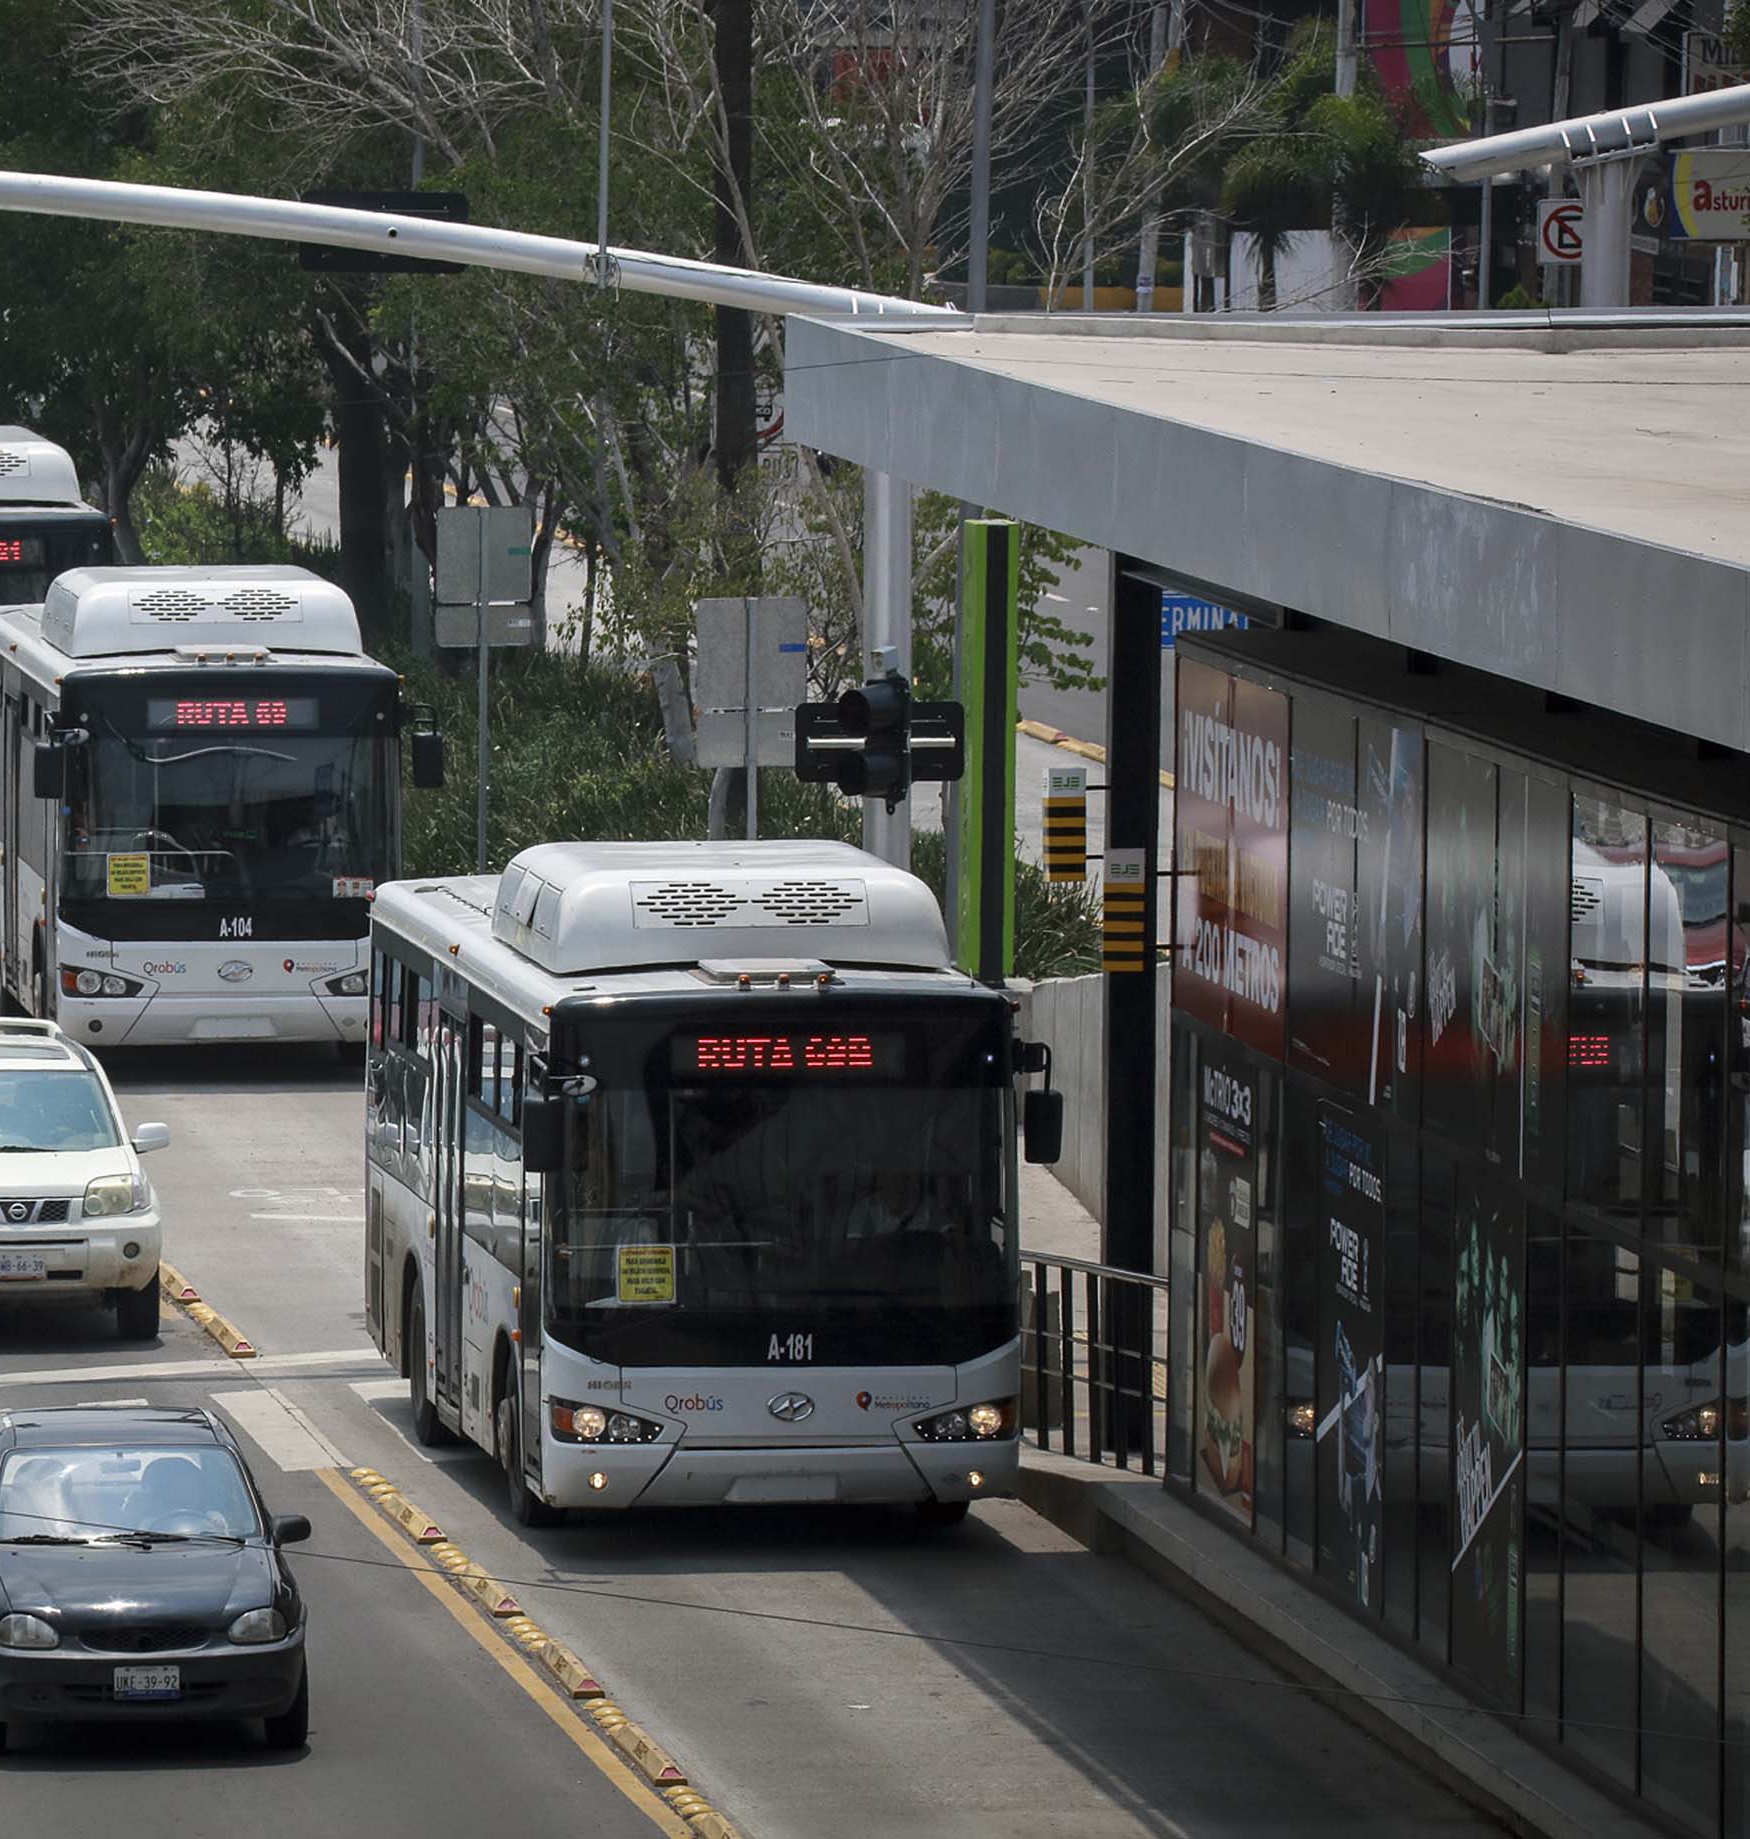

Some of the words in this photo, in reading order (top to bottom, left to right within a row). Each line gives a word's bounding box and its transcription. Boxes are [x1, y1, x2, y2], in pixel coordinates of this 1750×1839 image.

[177, 702, 250, 724] RUTA
[1313, 879, 1347, 923] POWER
[220, 917, 253, 937] A-104
[143, 960, 186, 976] Qrobús
[1194, 917, 1220, 985] 200
[1223, 926, 1279, 1014] METROS
[698, 1038, 793, 1067] RUTA
[1330, 1217, 1359, 1263] POWER
[768, 1334, 813, 1360] A-181
[664, 1394, 723, 1415] Qrobús
